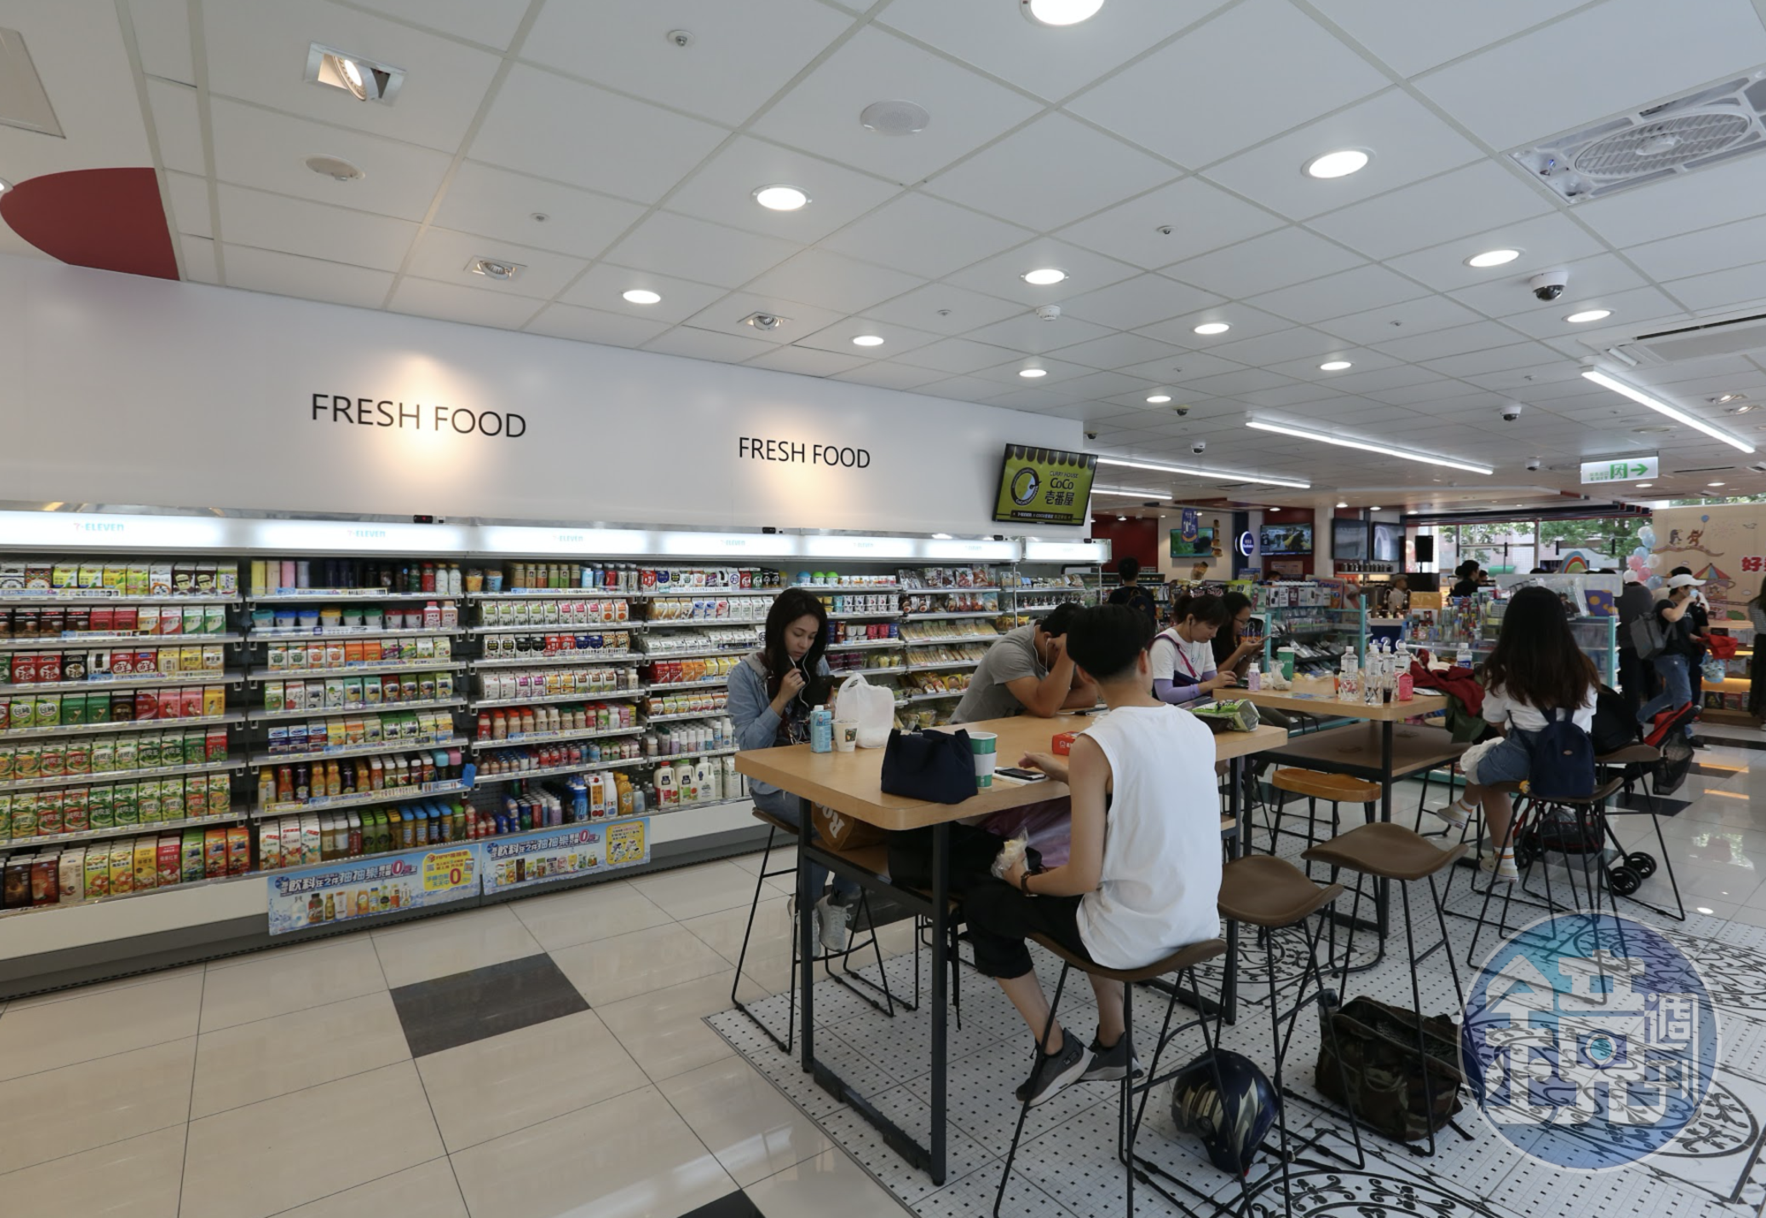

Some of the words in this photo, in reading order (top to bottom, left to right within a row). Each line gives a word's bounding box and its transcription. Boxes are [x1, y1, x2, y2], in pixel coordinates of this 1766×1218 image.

[312, 393, 420, 430] FRESH
[434, 405, 527, 438] FOOD
[739, 437, 805, 463] FRESH
[813, 444, 870, 469] FOOD
[1050, 477, 1074, 490] CoCo
